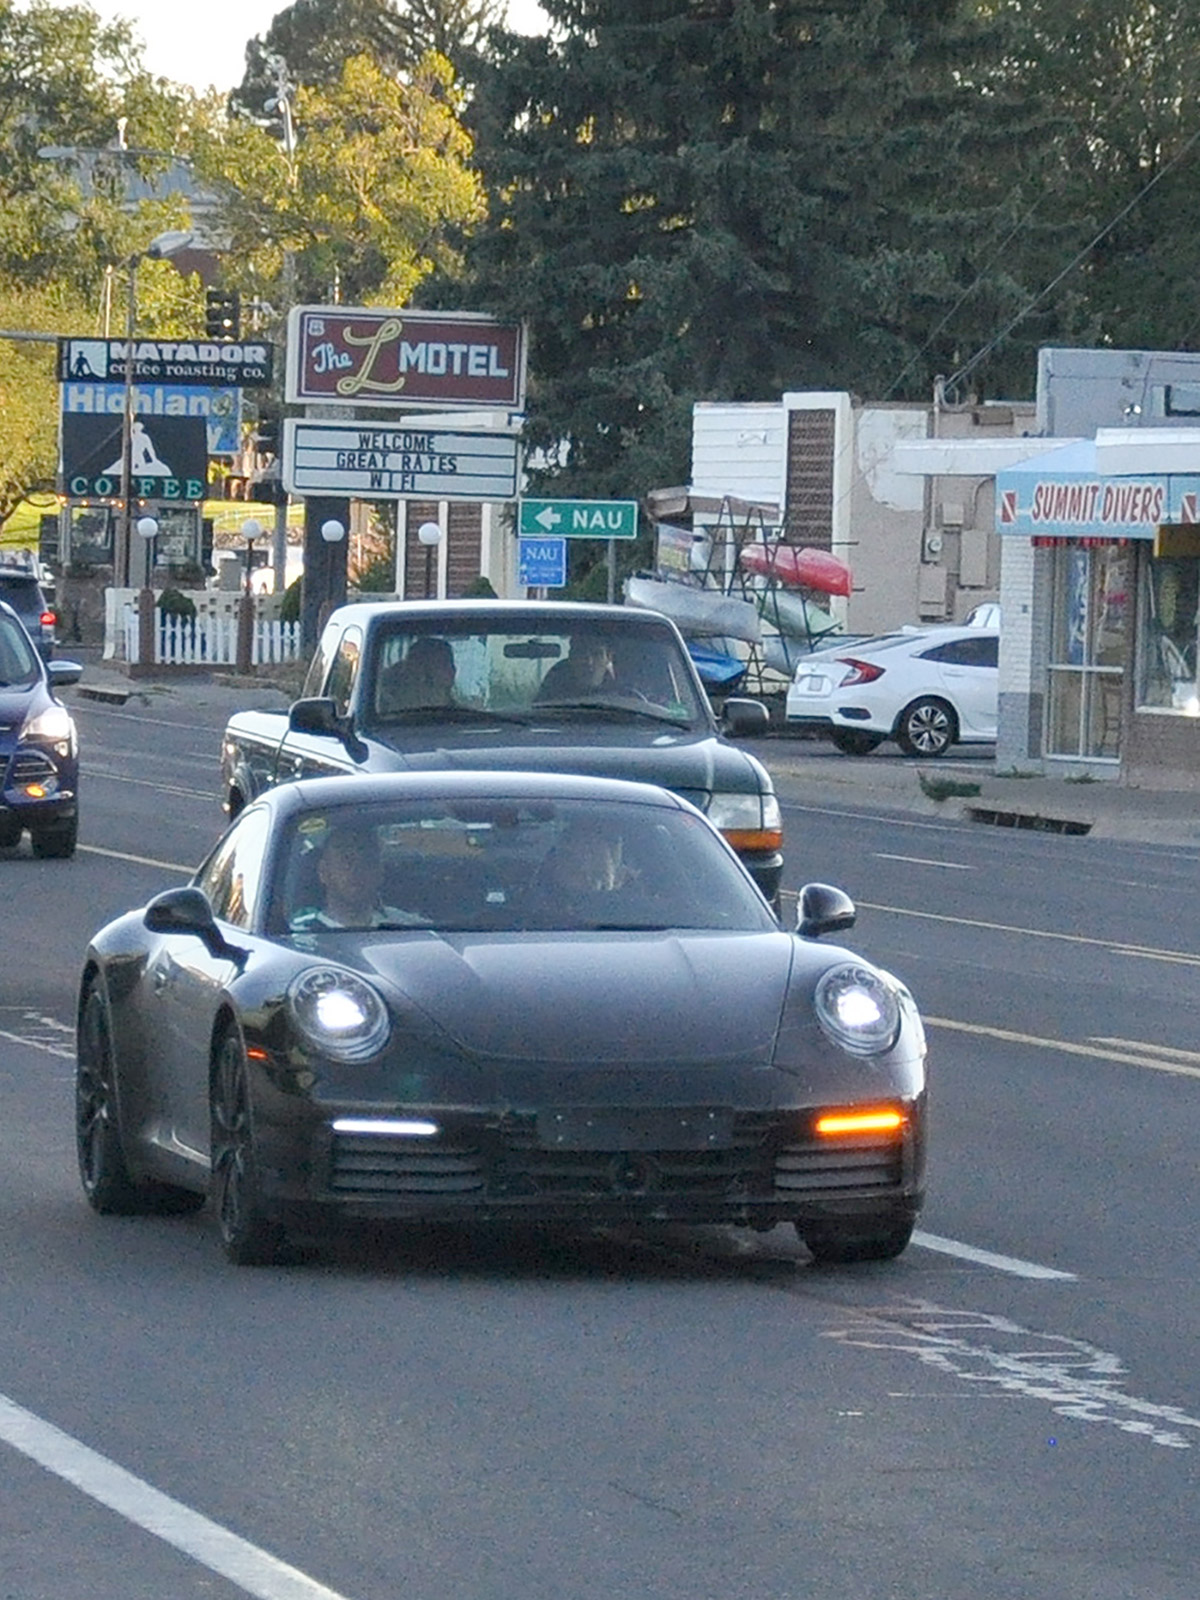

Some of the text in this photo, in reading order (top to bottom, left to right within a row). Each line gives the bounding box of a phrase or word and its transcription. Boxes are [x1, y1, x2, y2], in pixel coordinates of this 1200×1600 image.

[109, 342, 267, 364] MATADOR
[312, 318, 509, 395] The L MOTEL
[109, 361, 266, 381] cofee roasting co.
[358, 433, 436, 451] WELCOME
[336, 452, 458, 474] GREAT RATES
[1032, 482, 1164, 524] SUMMIT DIVERS
[572, 509, 623, 529] NAU
[526, 547, 558, 561] NAU
